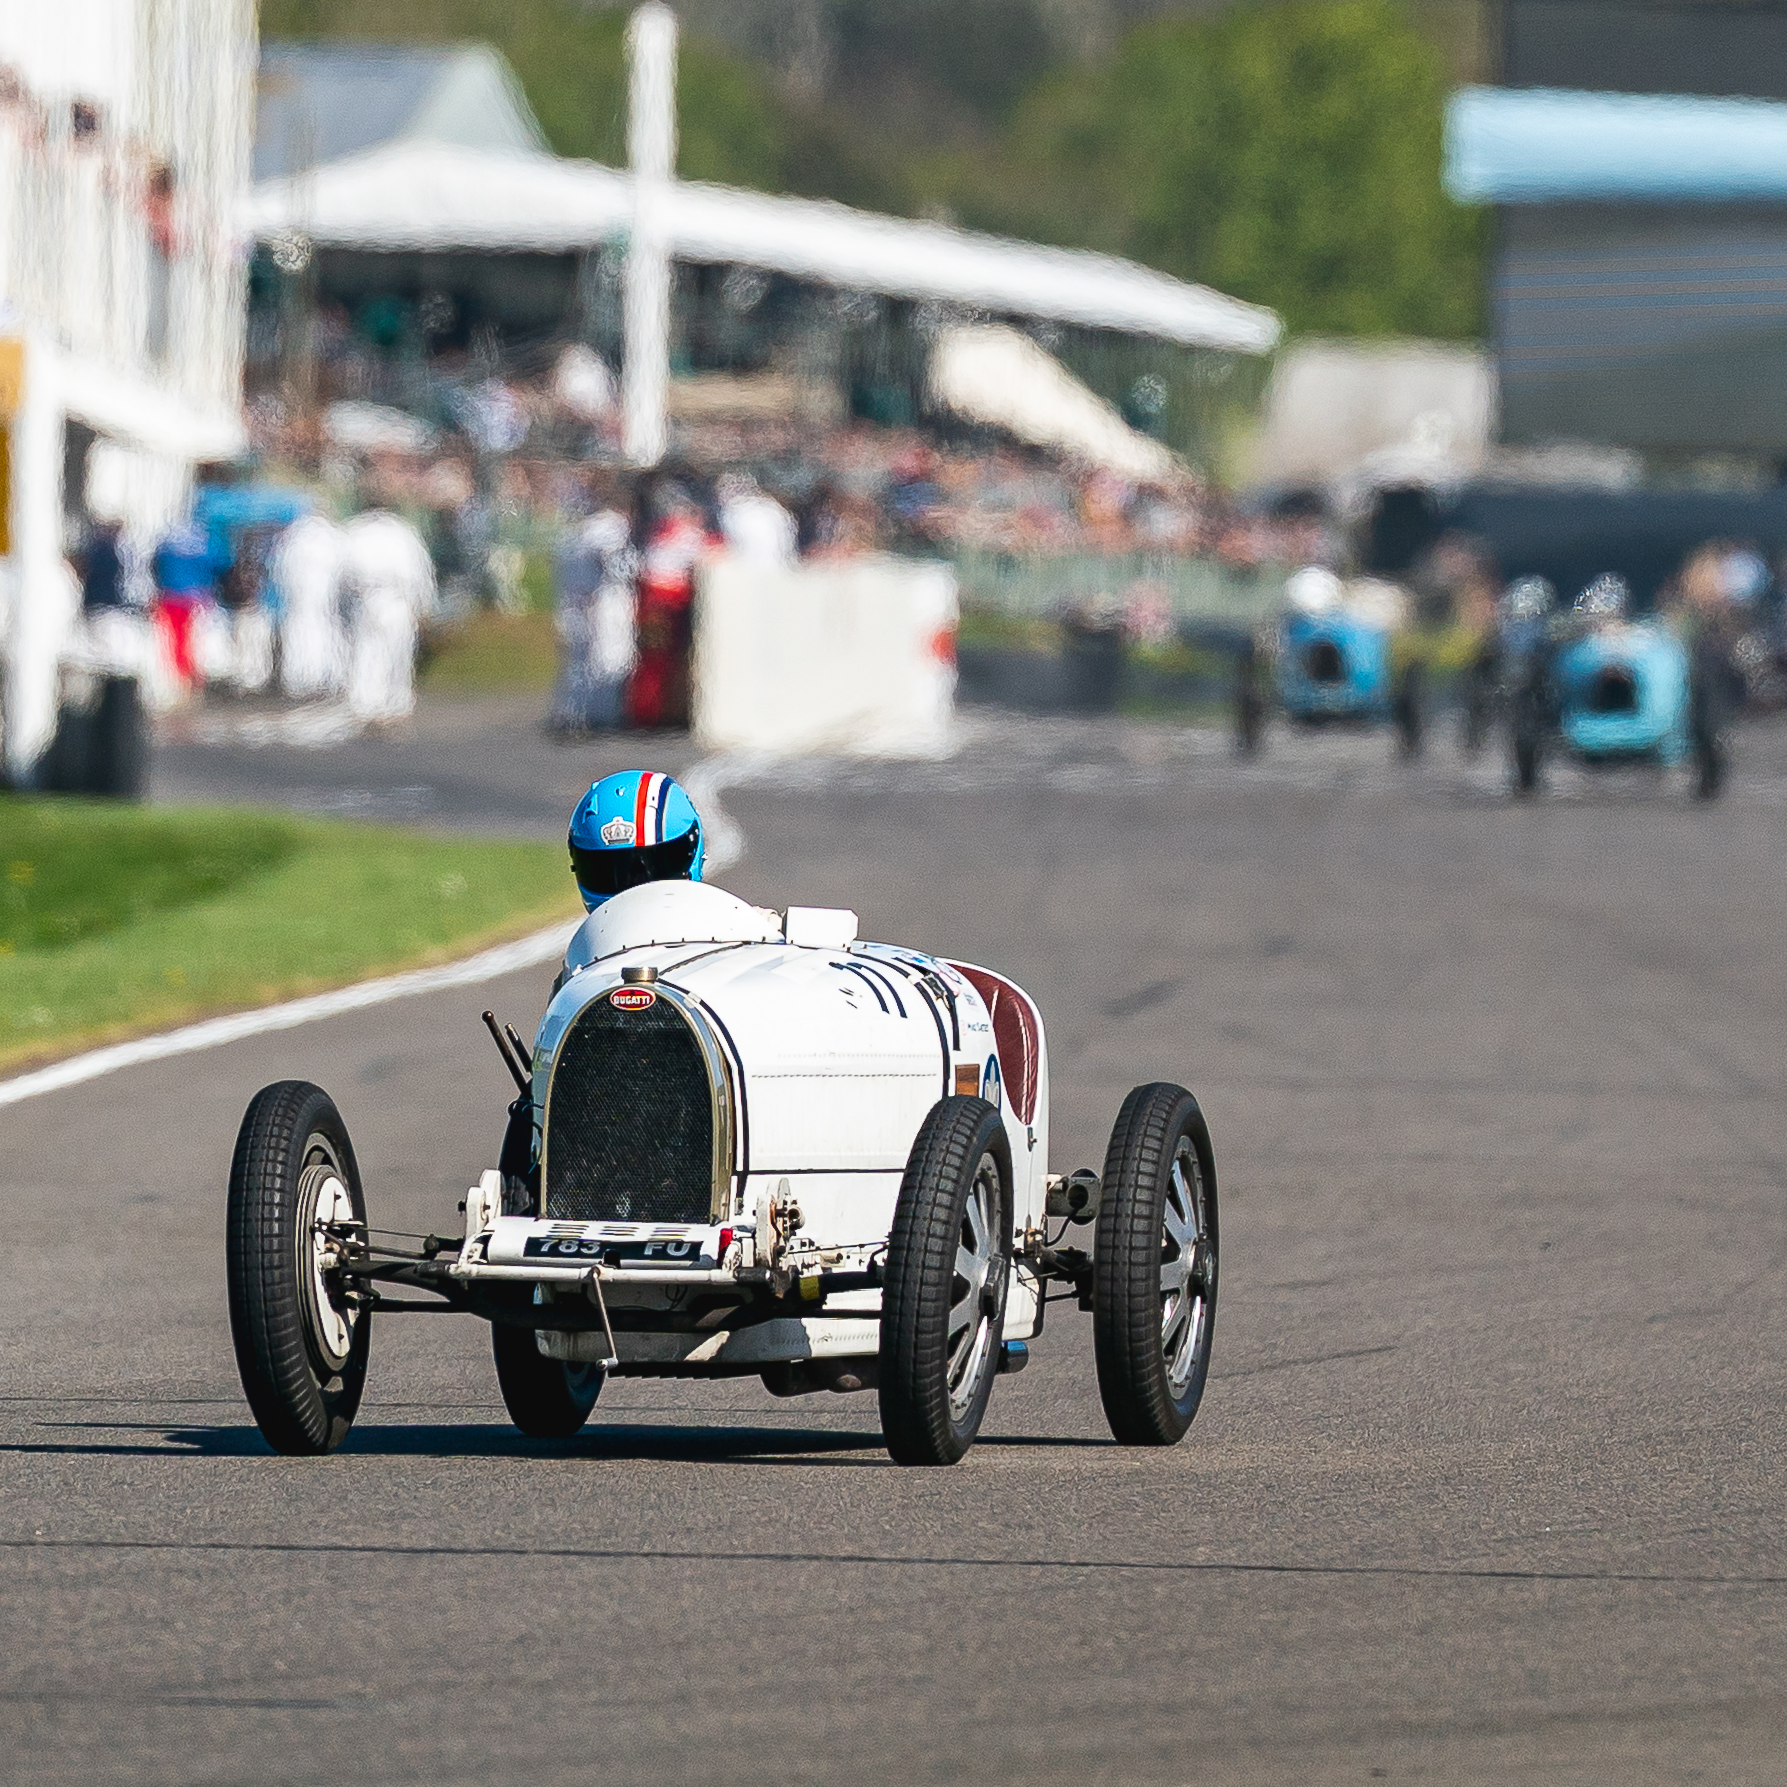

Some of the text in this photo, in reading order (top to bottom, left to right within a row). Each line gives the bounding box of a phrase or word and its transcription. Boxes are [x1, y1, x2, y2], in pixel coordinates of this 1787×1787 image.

[613, 995, 650, 1004] BUGATTI
[539, 1238, 691, 1256] 783 FU
